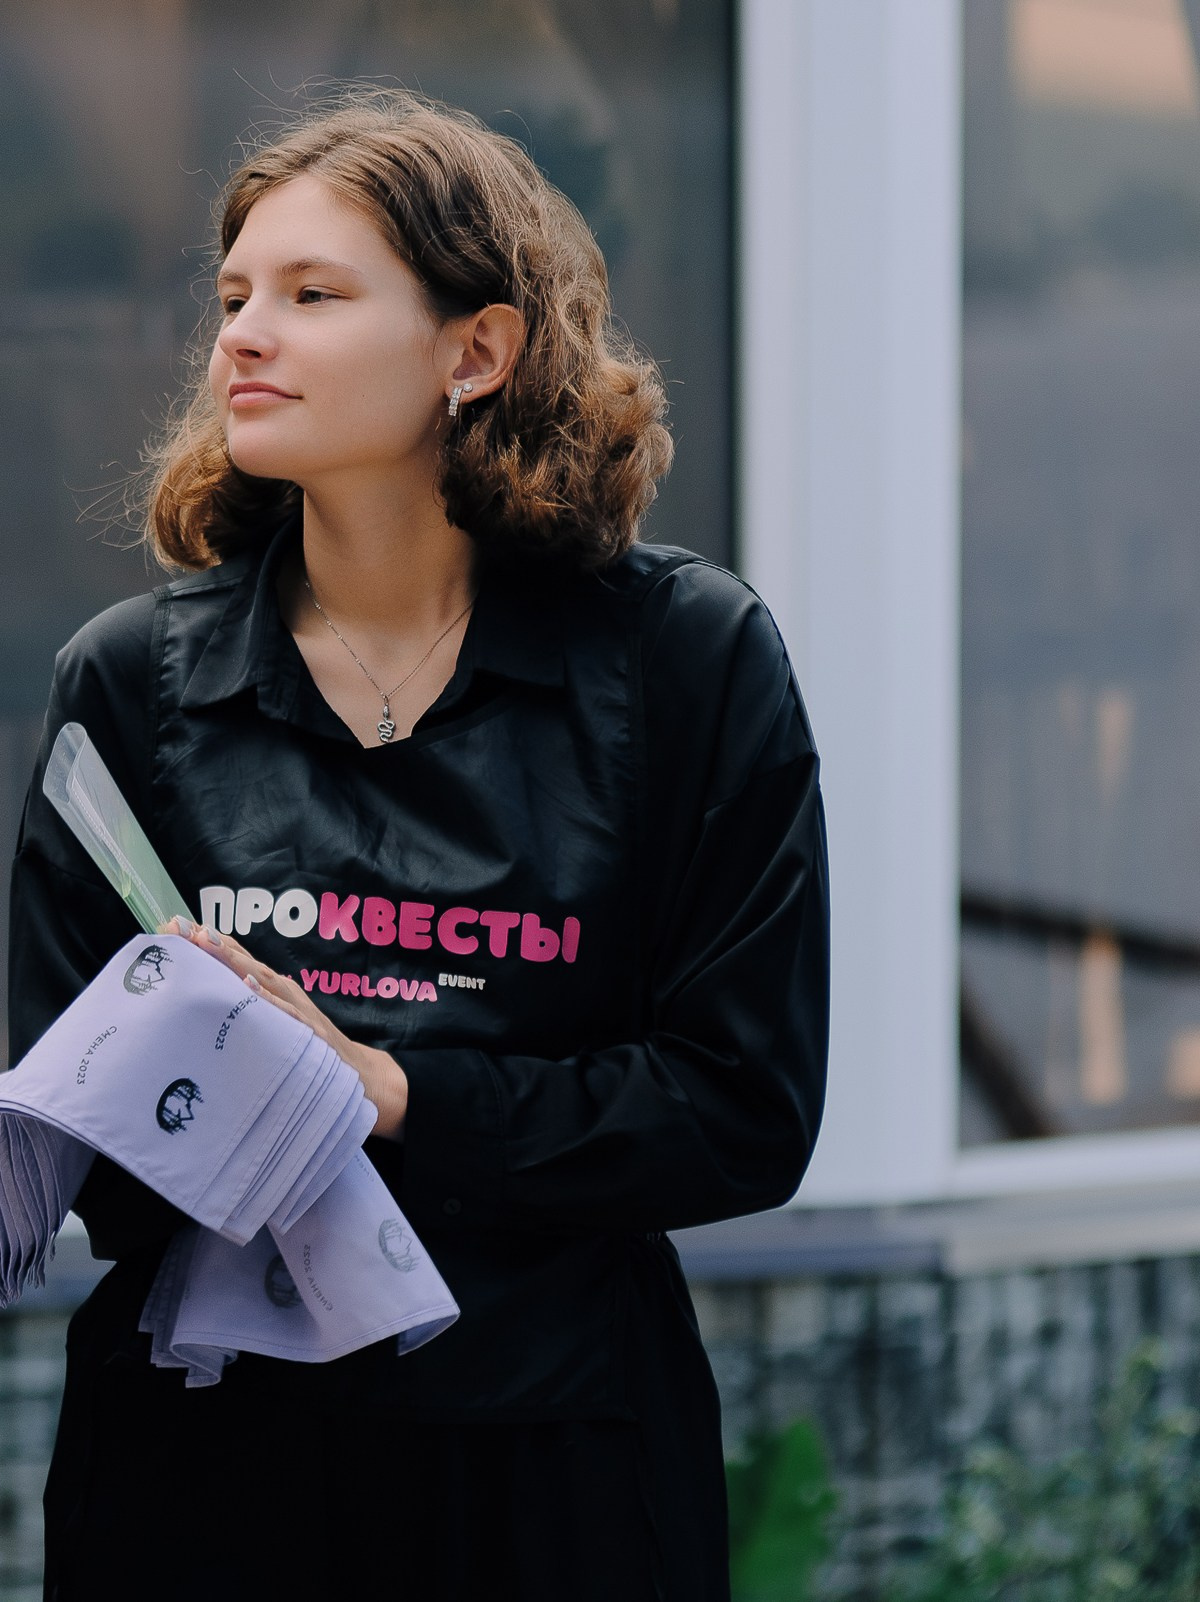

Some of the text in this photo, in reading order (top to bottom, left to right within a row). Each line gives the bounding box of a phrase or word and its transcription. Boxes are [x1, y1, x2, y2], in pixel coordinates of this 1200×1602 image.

[200, 886, 581, 964] ПРОКВЕСТЫ
[300, 968, 486, 1003] YURLOVA EVENT
[76, 1025, 118, 1085] СМЕНА 2023
[215, 1021, 230, 1051] 2023
